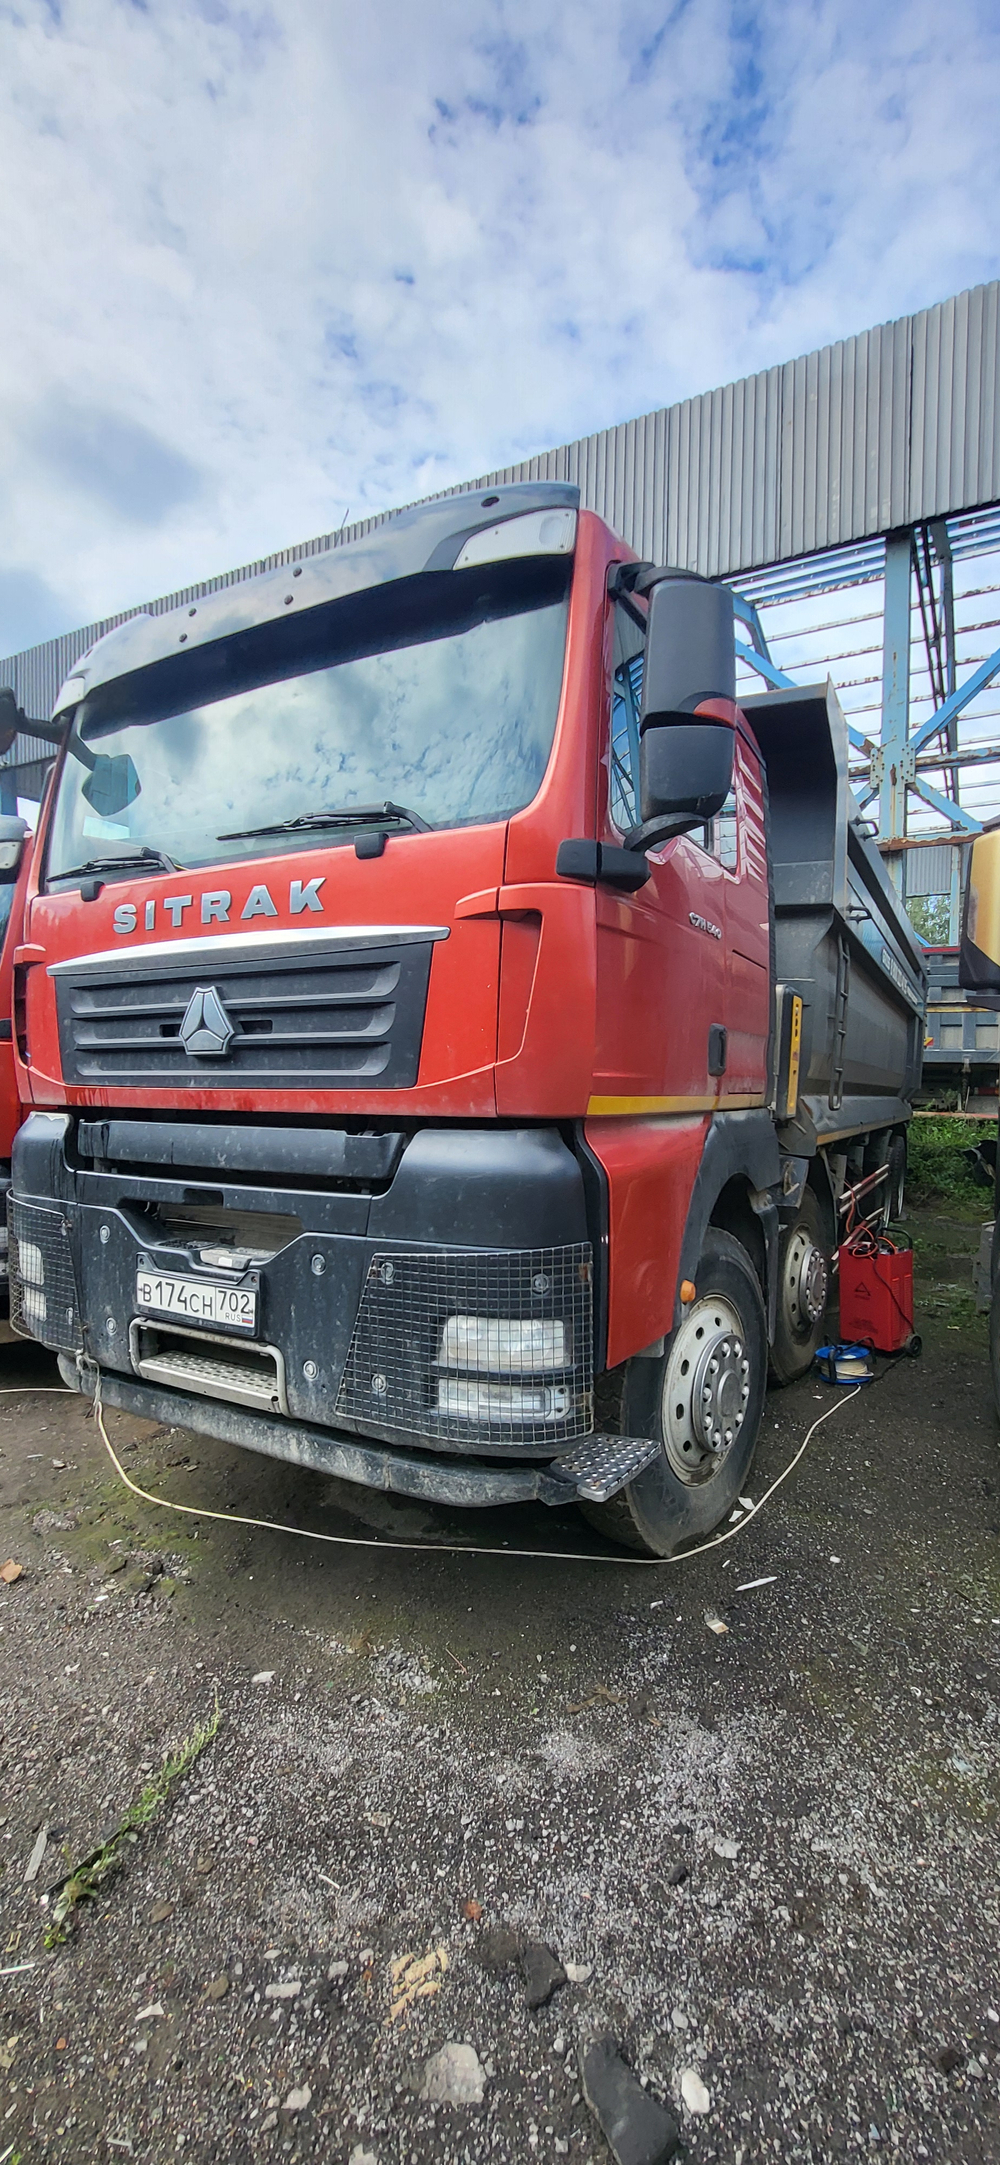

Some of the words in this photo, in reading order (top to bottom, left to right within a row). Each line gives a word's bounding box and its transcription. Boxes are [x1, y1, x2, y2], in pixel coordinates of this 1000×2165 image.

[112, 877, 326, 934] SITRAK
[217, 1289, 251, 1315] 702
[224, 1312, 242, 1323] RUS
